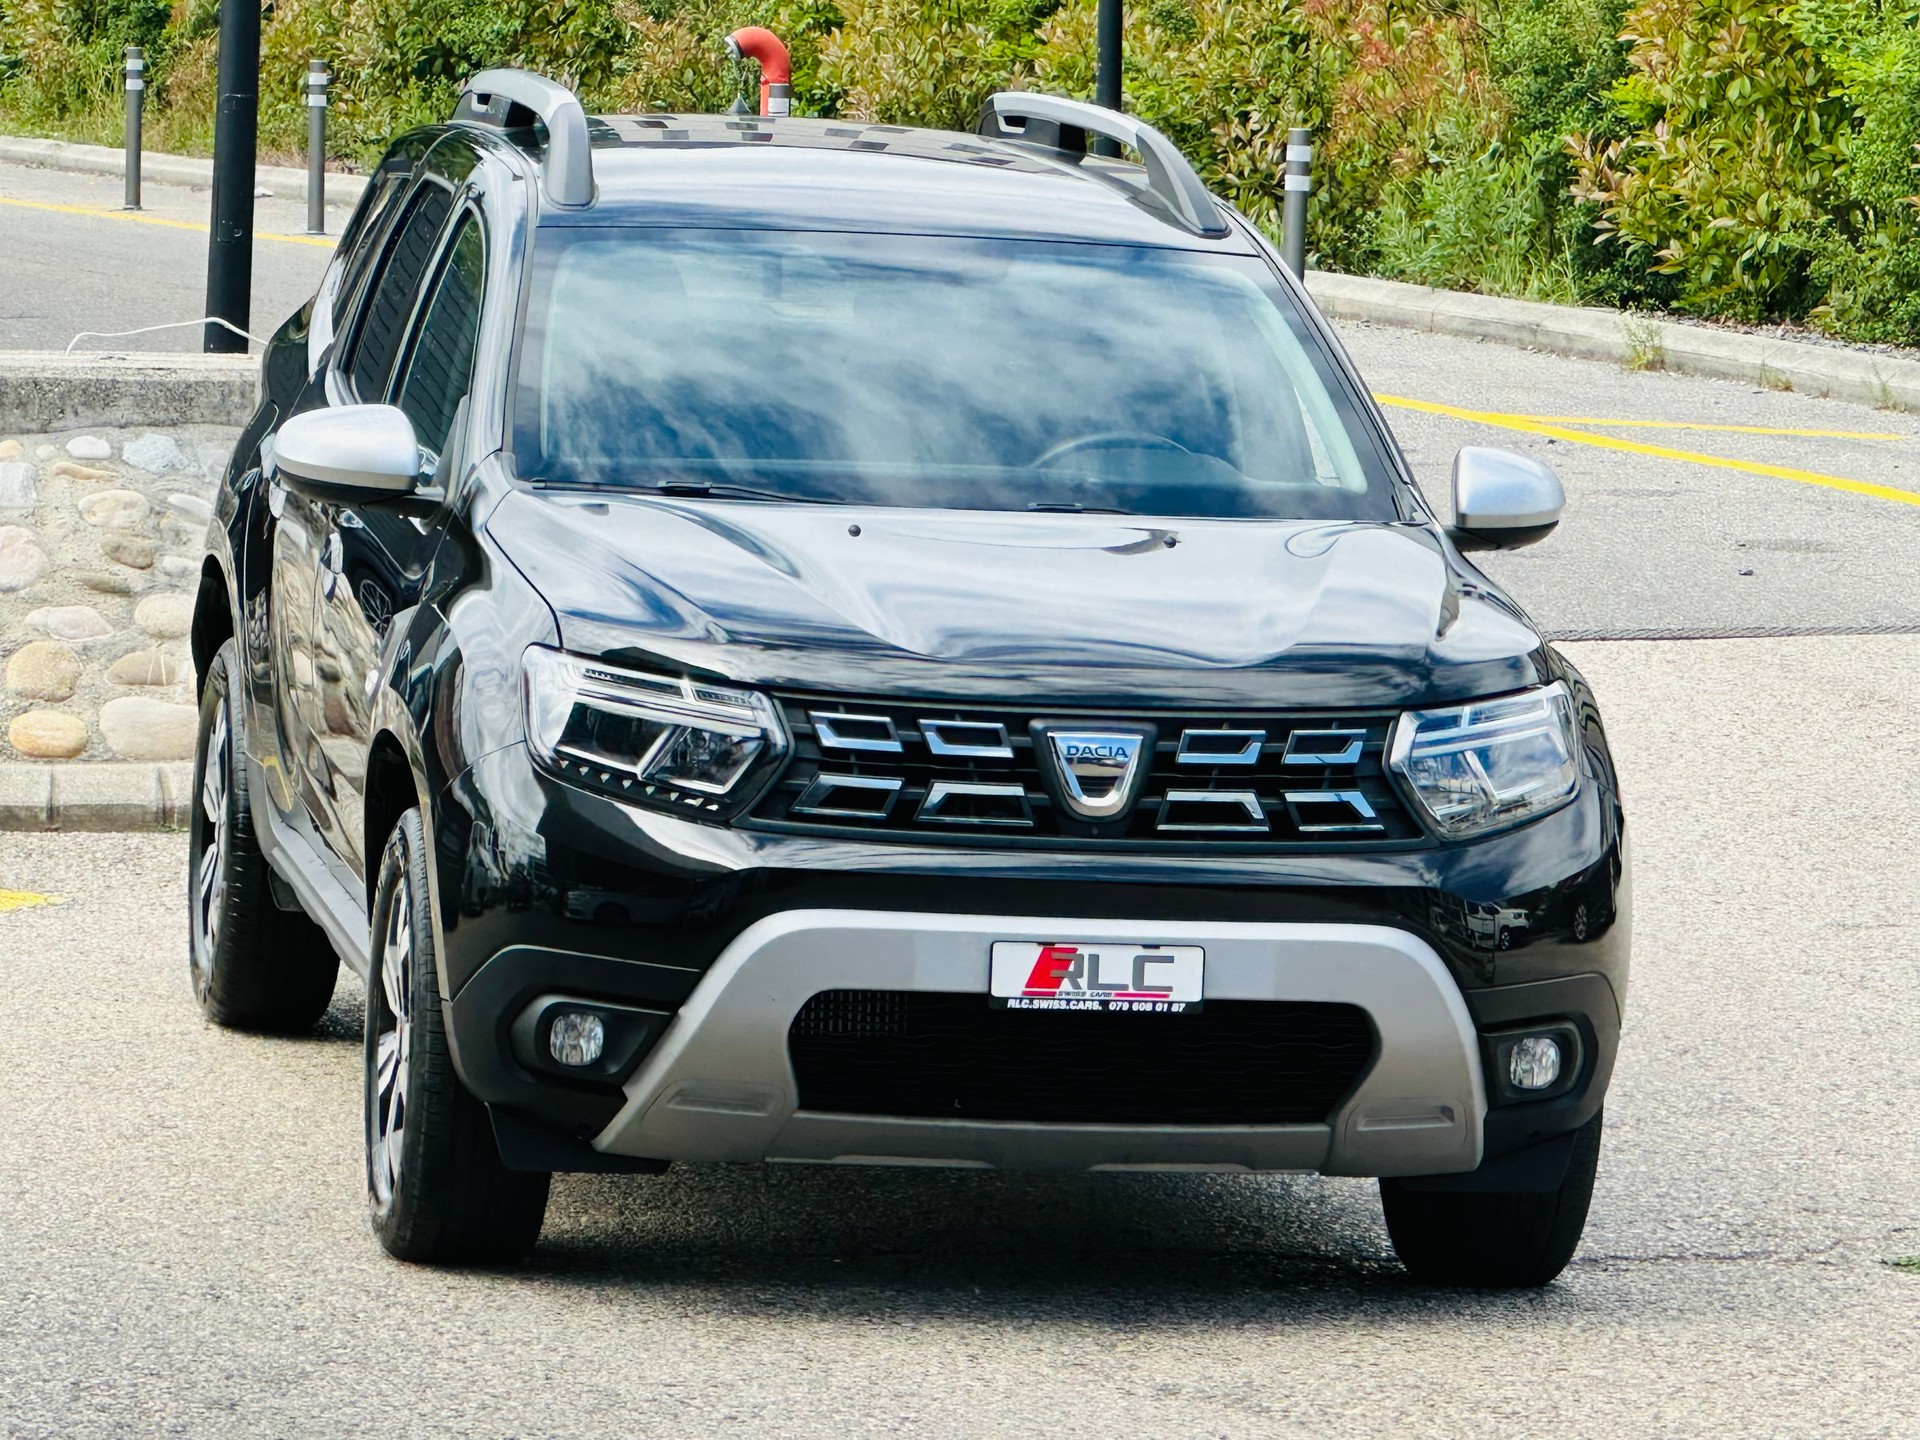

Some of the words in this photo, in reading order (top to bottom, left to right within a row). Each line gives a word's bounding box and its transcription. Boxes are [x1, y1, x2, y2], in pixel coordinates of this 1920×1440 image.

[1067, 745, 1129, 758] DACIA
[1050, 952, 1174, 992] RLC
[1108, 1001, 1129, 1011] 079
